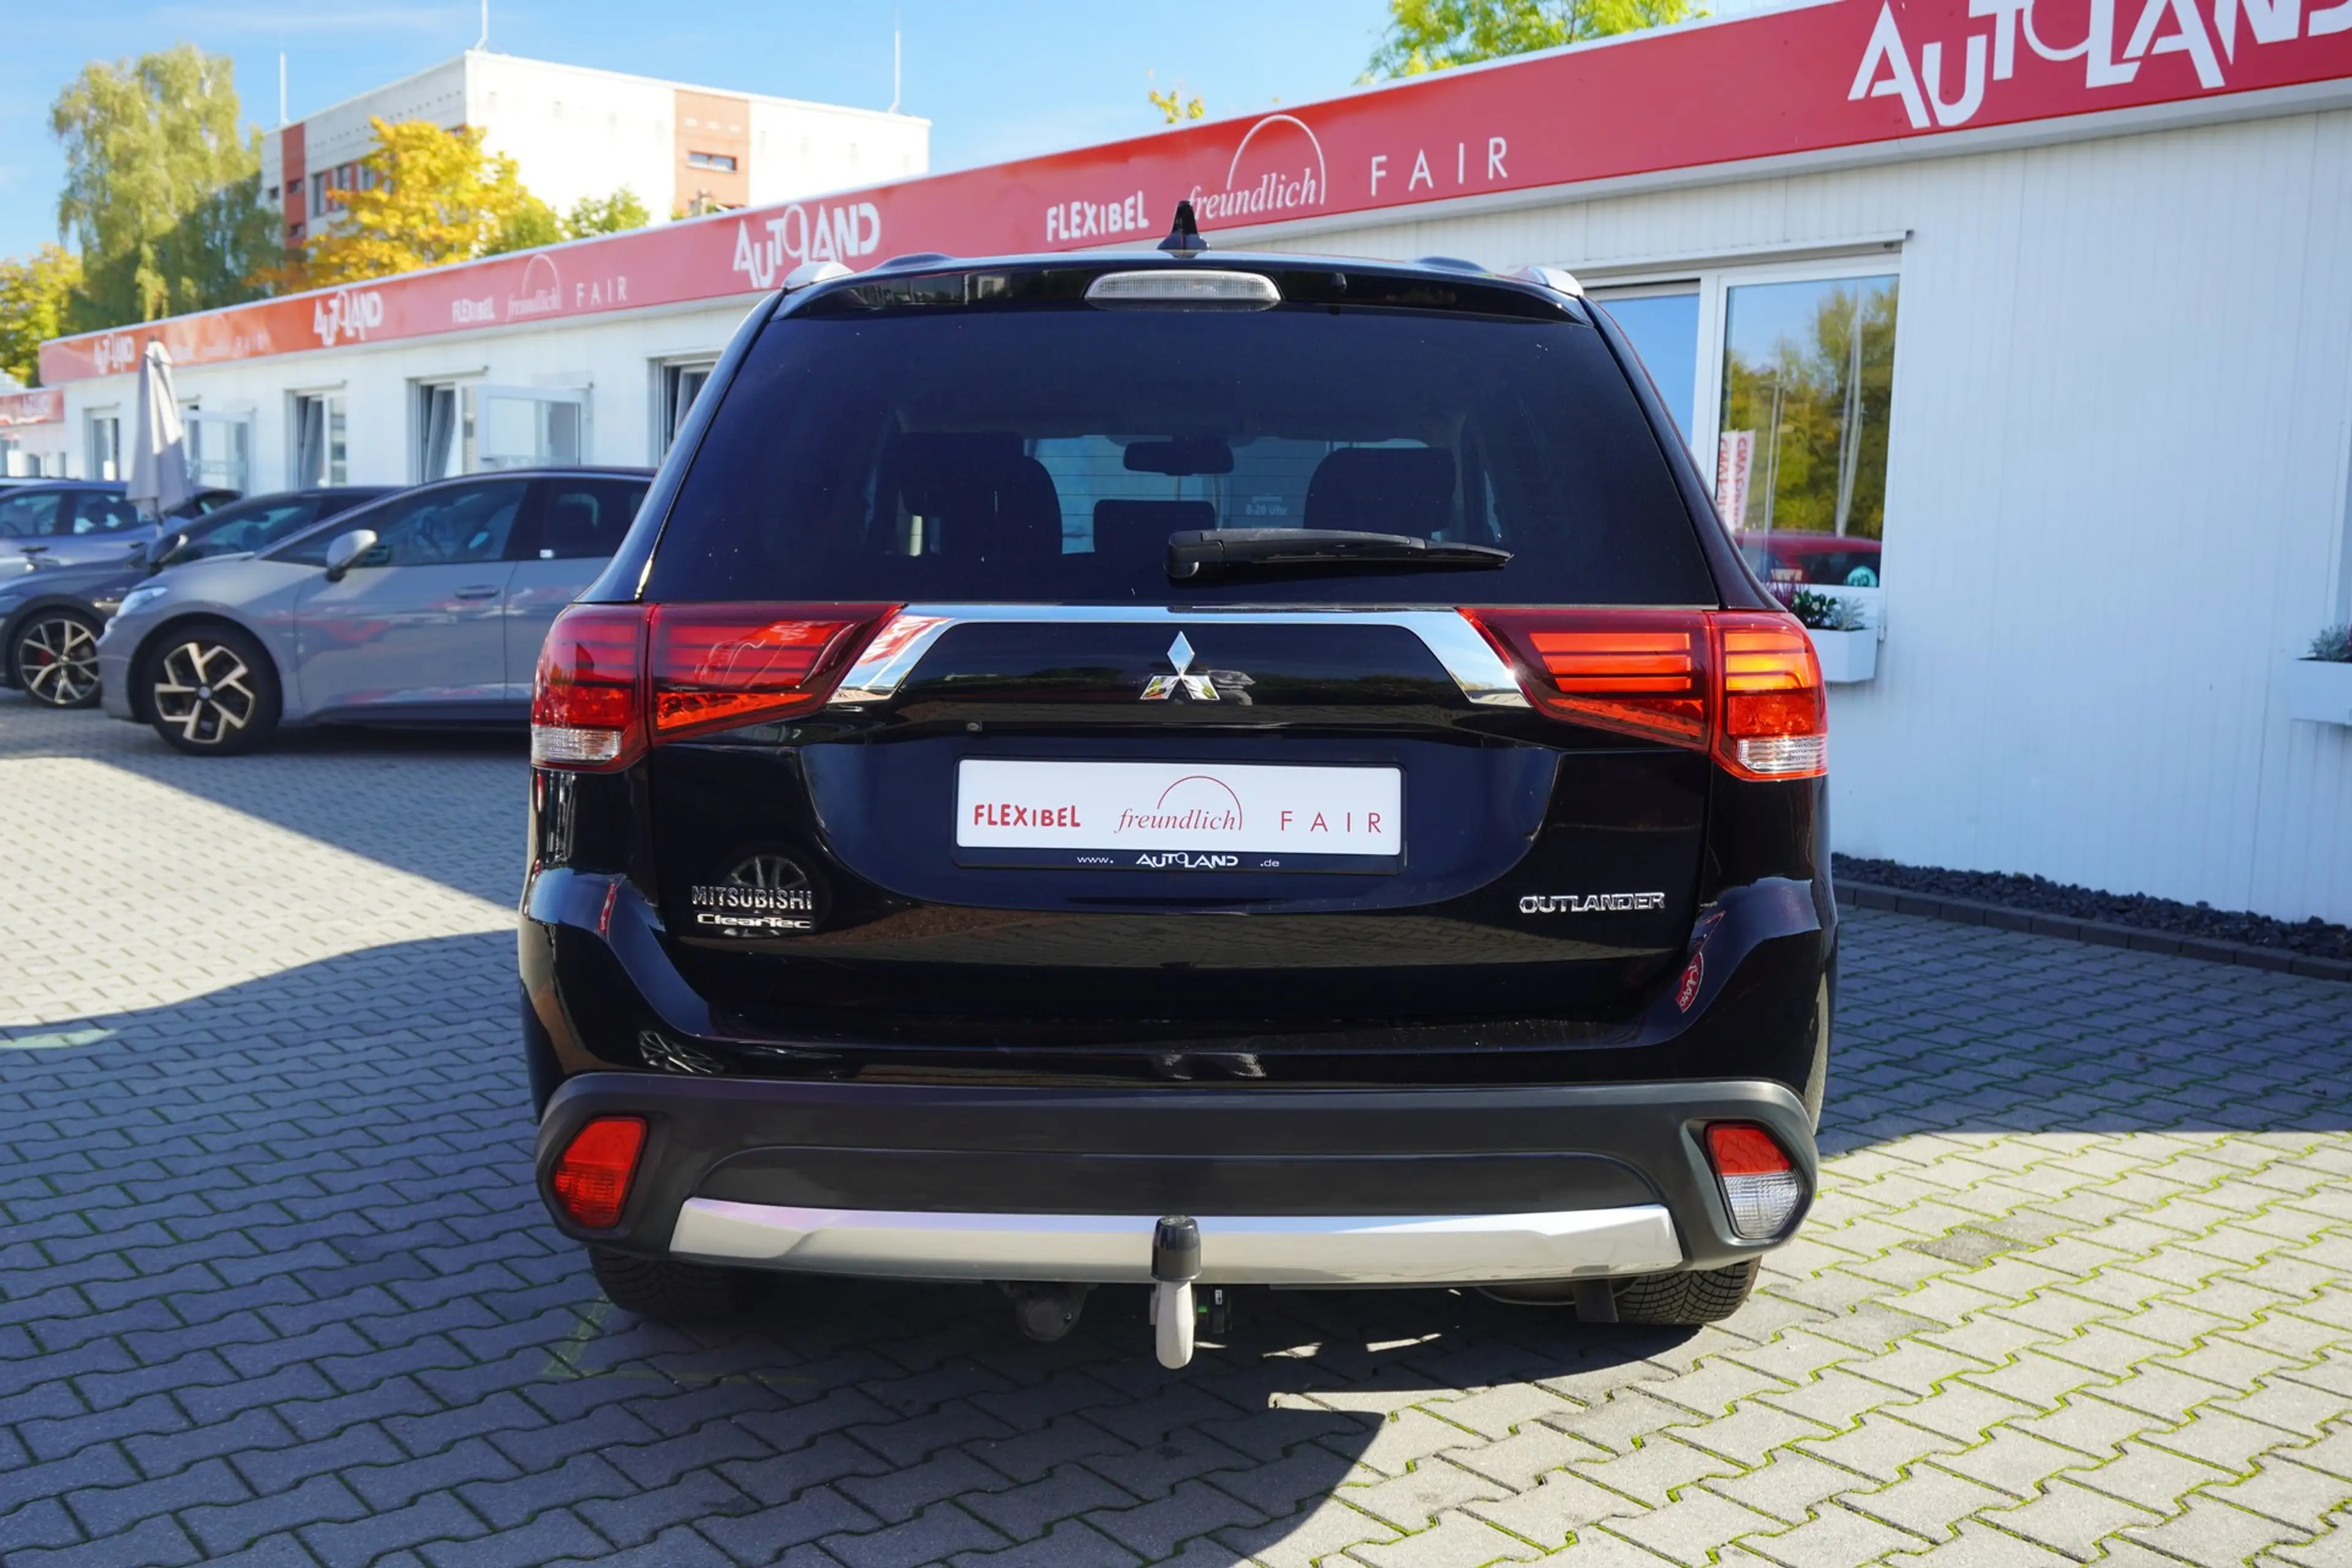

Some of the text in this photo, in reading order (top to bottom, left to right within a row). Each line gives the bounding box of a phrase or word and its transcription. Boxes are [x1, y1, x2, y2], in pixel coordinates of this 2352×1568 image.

[1847, 0, 2352, 129] AUTOLAN
[1046, 137, 1509, 243] FLEXIBEL freundlich FAIR
[733, 204, 881, 288] AUTOLAND
[576, 276, 627, 307] FAIR
[974, 804, 1382, 834] FLEXIBEL freundlich FAIR
[1077, 852, 1280, 869] www. AUTOLAND .de
[692, 886, 812, 910] MITSUBISHI
[1519, 892, 1665, 913] OUTLANDER
[696, 913, 811, 929] ClearTec
